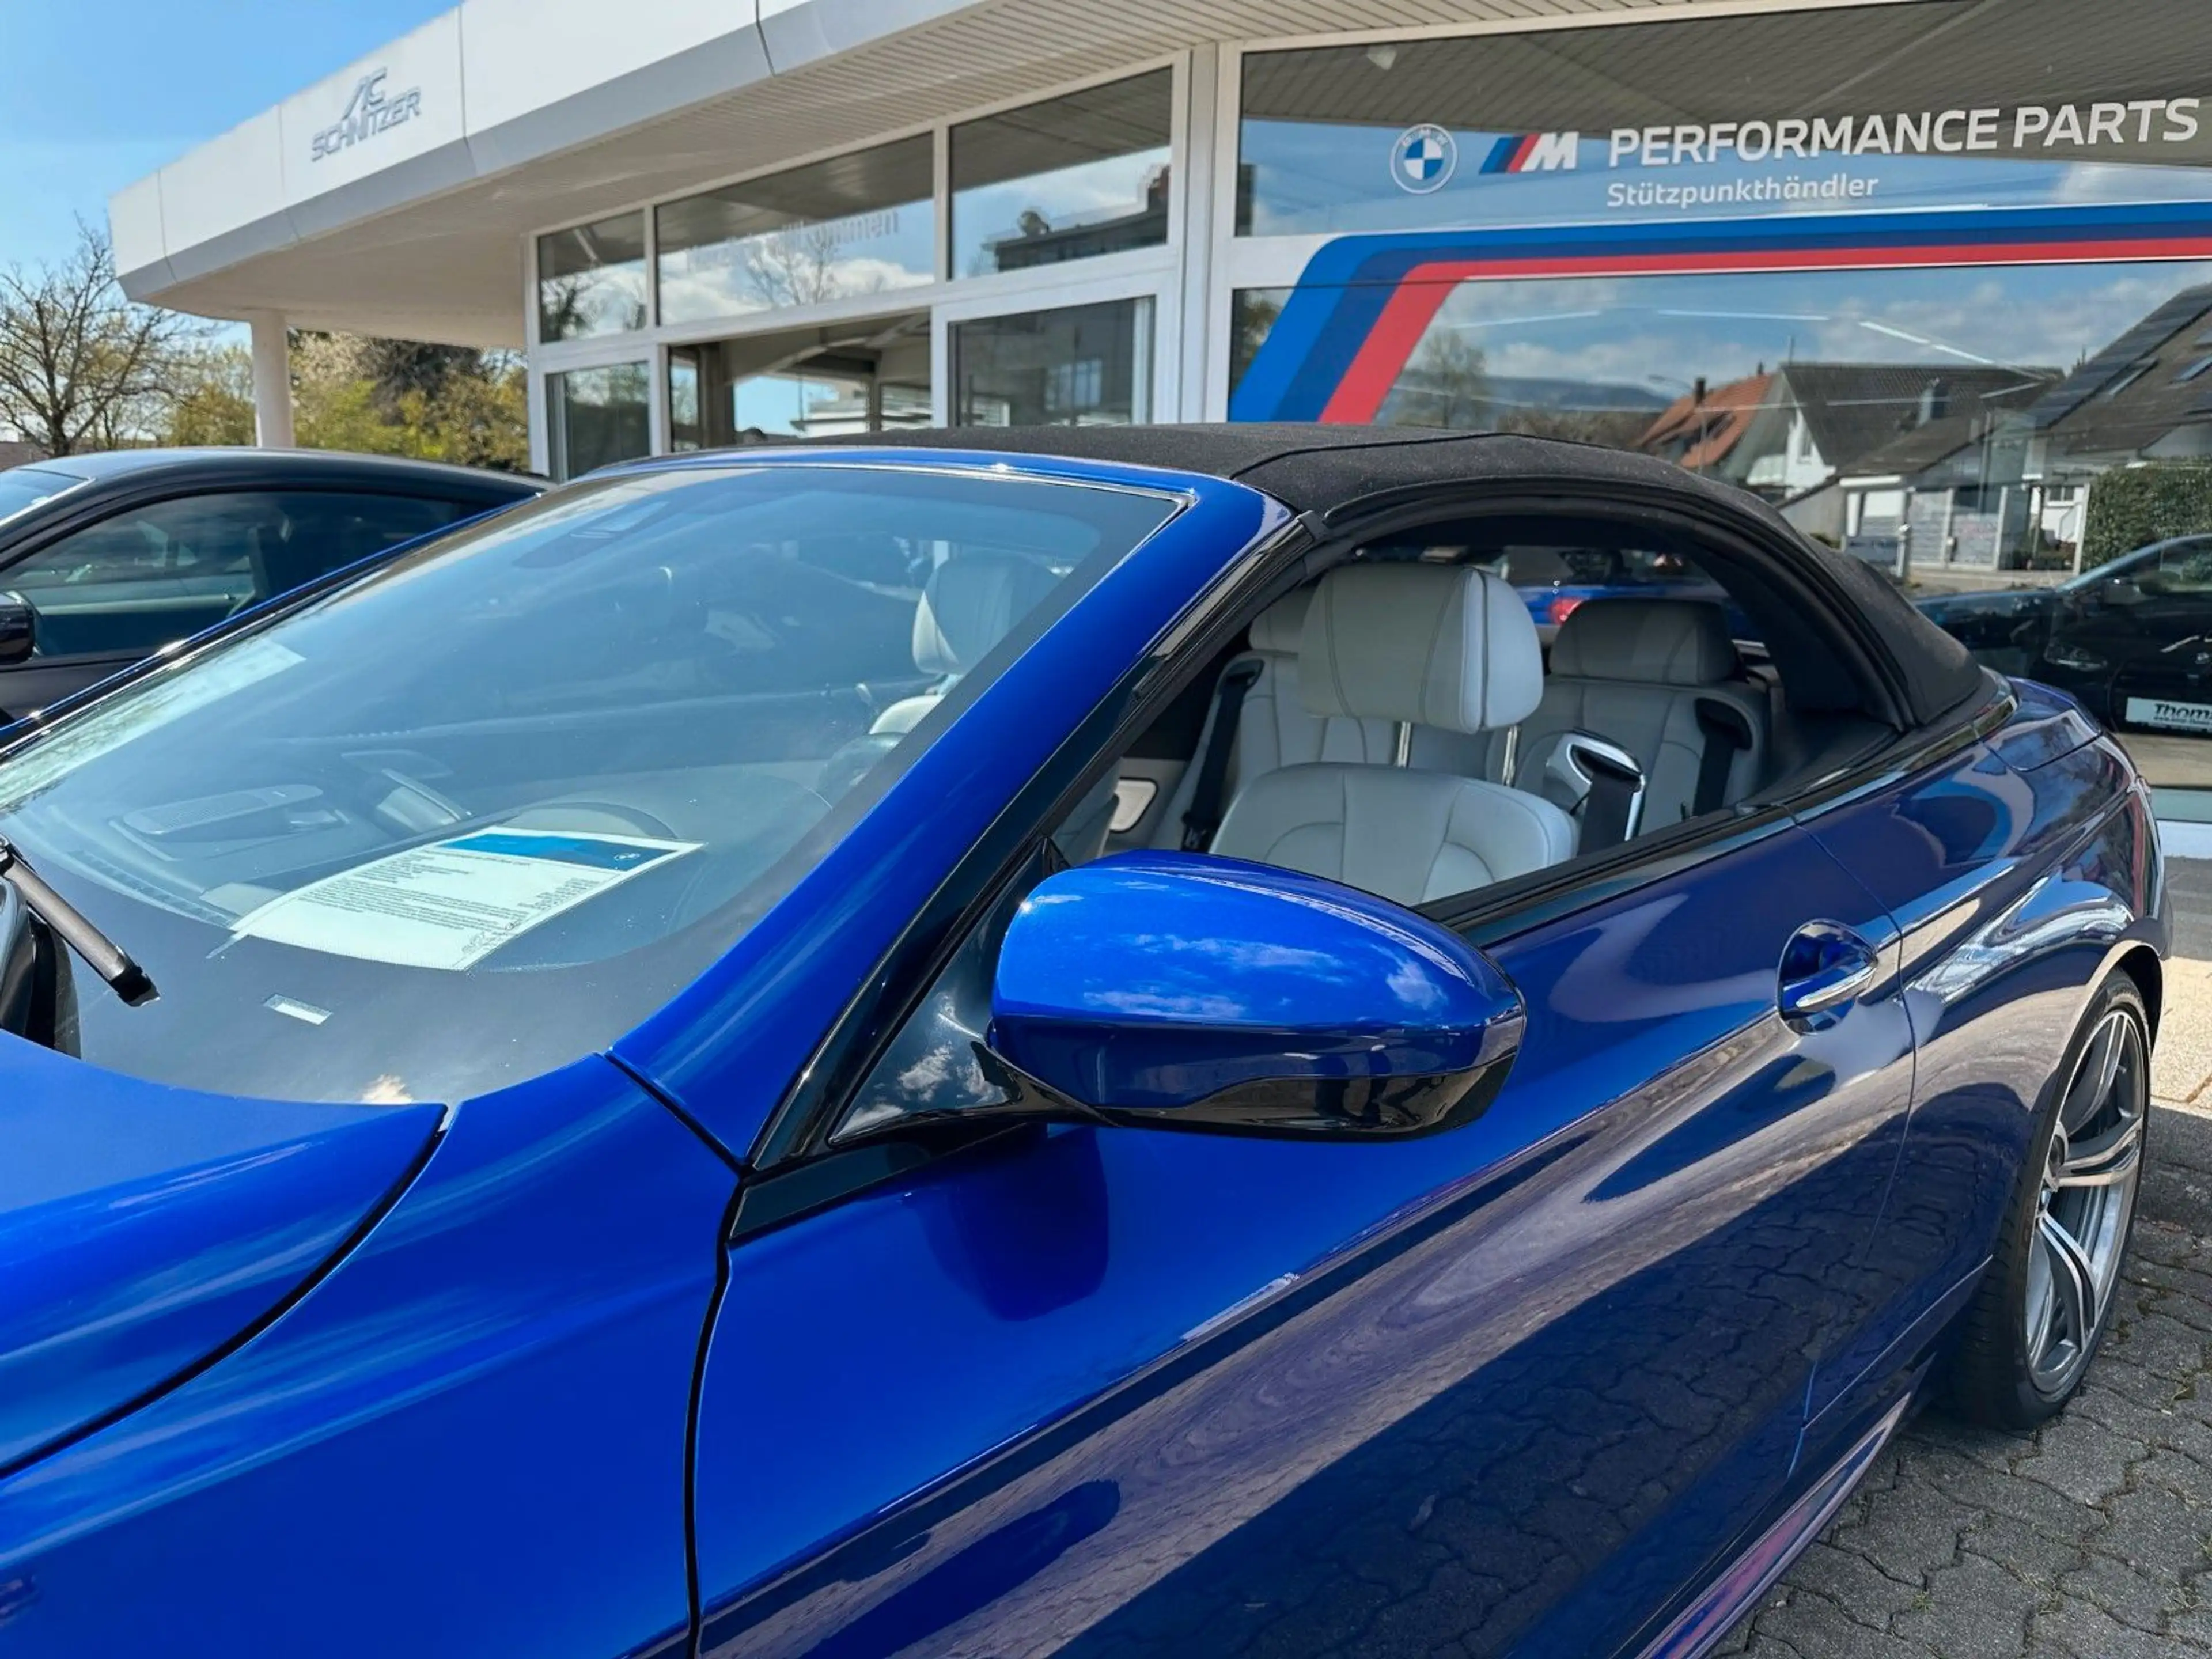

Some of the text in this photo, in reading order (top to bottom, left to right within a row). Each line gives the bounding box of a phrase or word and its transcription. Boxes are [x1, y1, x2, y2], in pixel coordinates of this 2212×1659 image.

[311, 86, 422, 162] SCHNITZER
[1520, 97, 2200, 172] M PERFORMANCE PARTS
[1606, 173, 1880, 209] Stützpunkthändler
